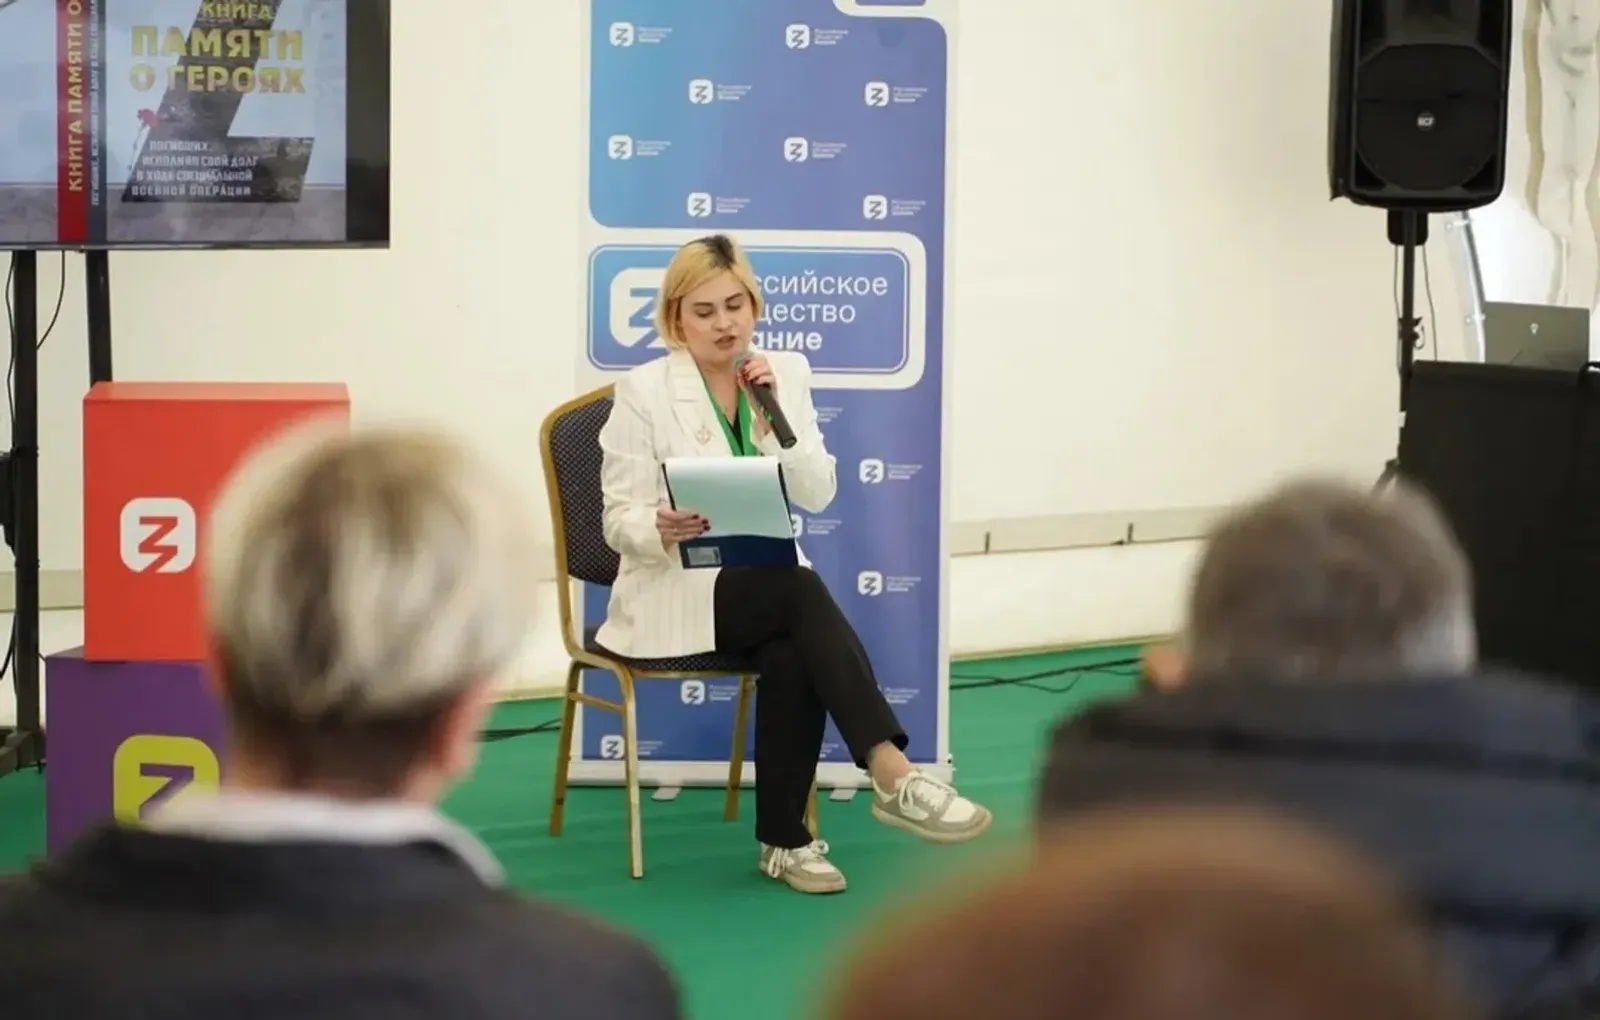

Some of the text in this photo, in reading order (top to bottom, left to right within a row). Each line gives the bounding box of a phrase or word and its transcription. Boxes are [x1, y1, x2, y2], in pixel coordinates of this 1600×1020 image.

[201, 3, 273, 20] КНИГА
[131, 25, 304, 60] ПАМЯТИ
[68, 23, 84, 114] ПАМЯТИ
[129, 63, 306, 94] О ГЕРОЯХ
[68, 120, 83, 191] КНИГА
[755, 269, 888, 296] сийское
[757, 302, 856, 325] ество
[751, 330, 823, 350] ание
